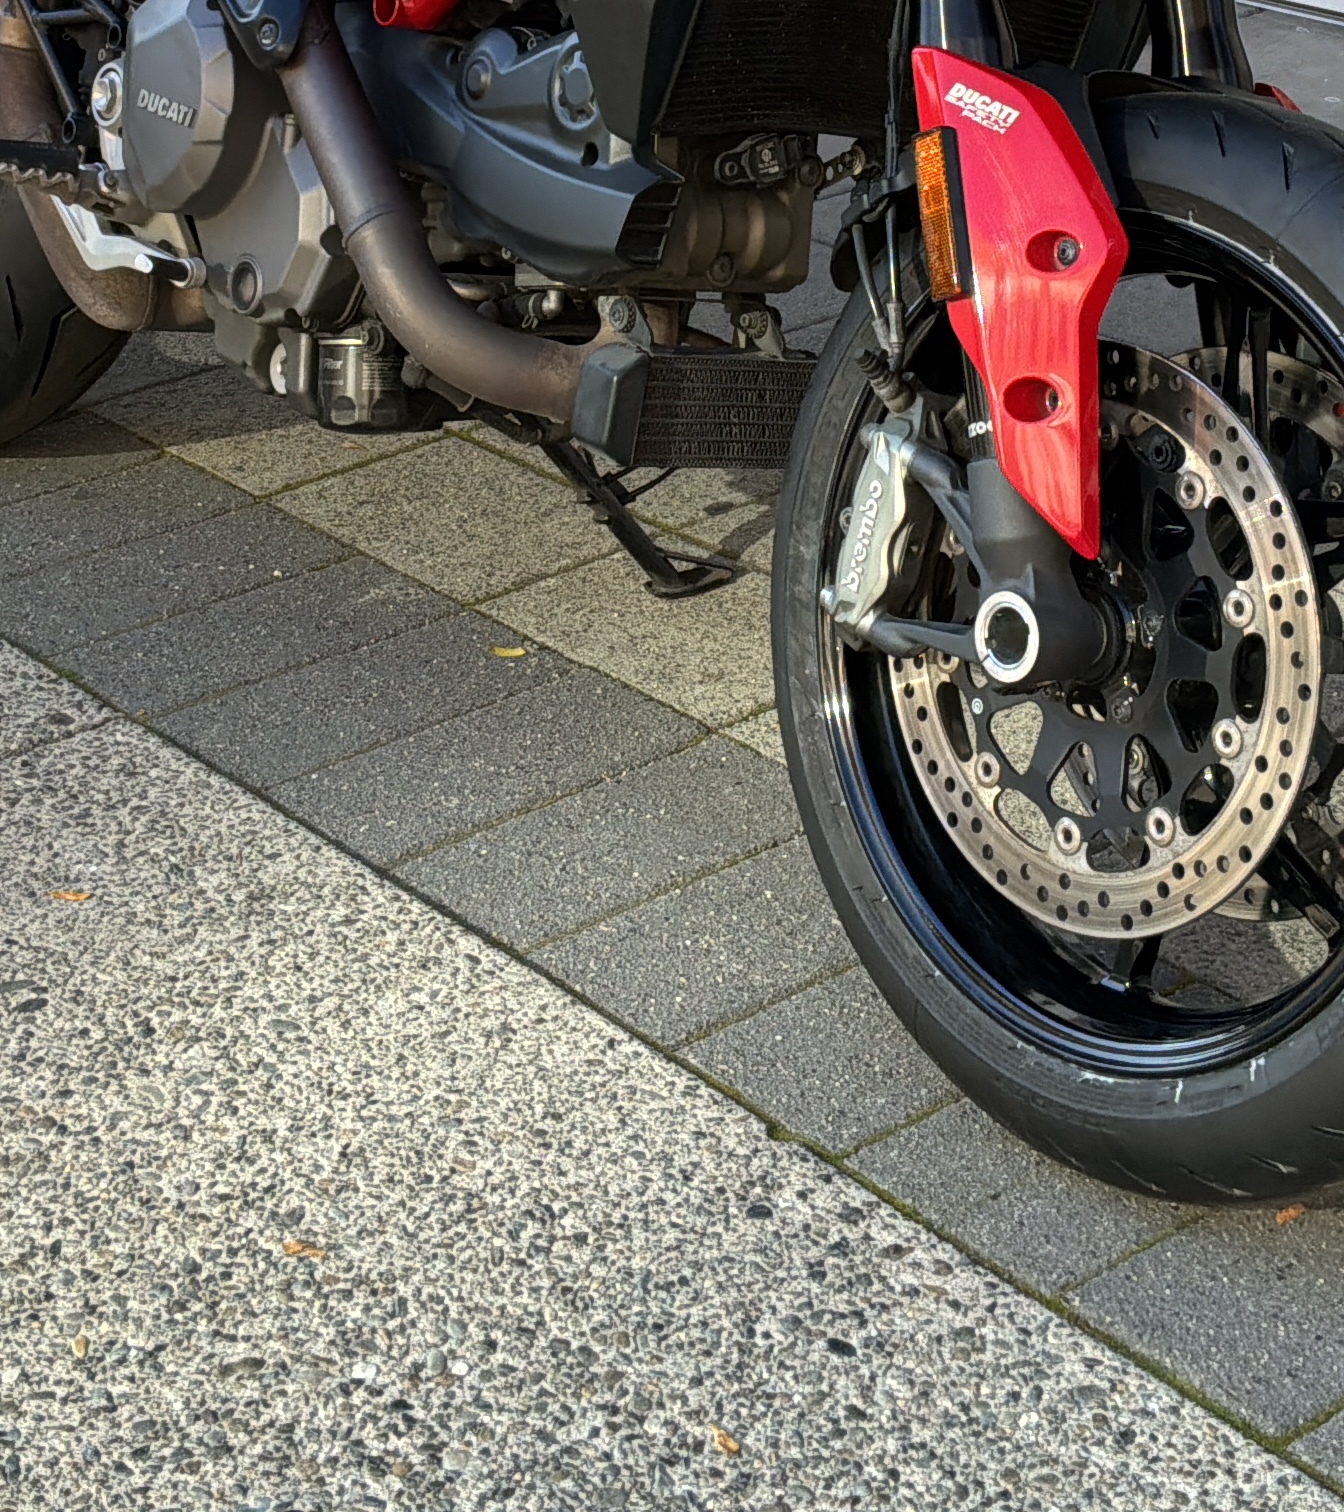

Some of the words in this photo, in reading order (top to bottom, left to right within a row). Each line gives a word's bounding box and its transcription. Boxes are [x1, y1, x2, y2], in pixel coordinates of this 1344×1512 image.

[136, 88, 194, 127] DUCATI
[948, 81, 1021, 126] DUCATI
[960, 109, 1007, 135] PACK
[840, 479, 883, 593] brembo
